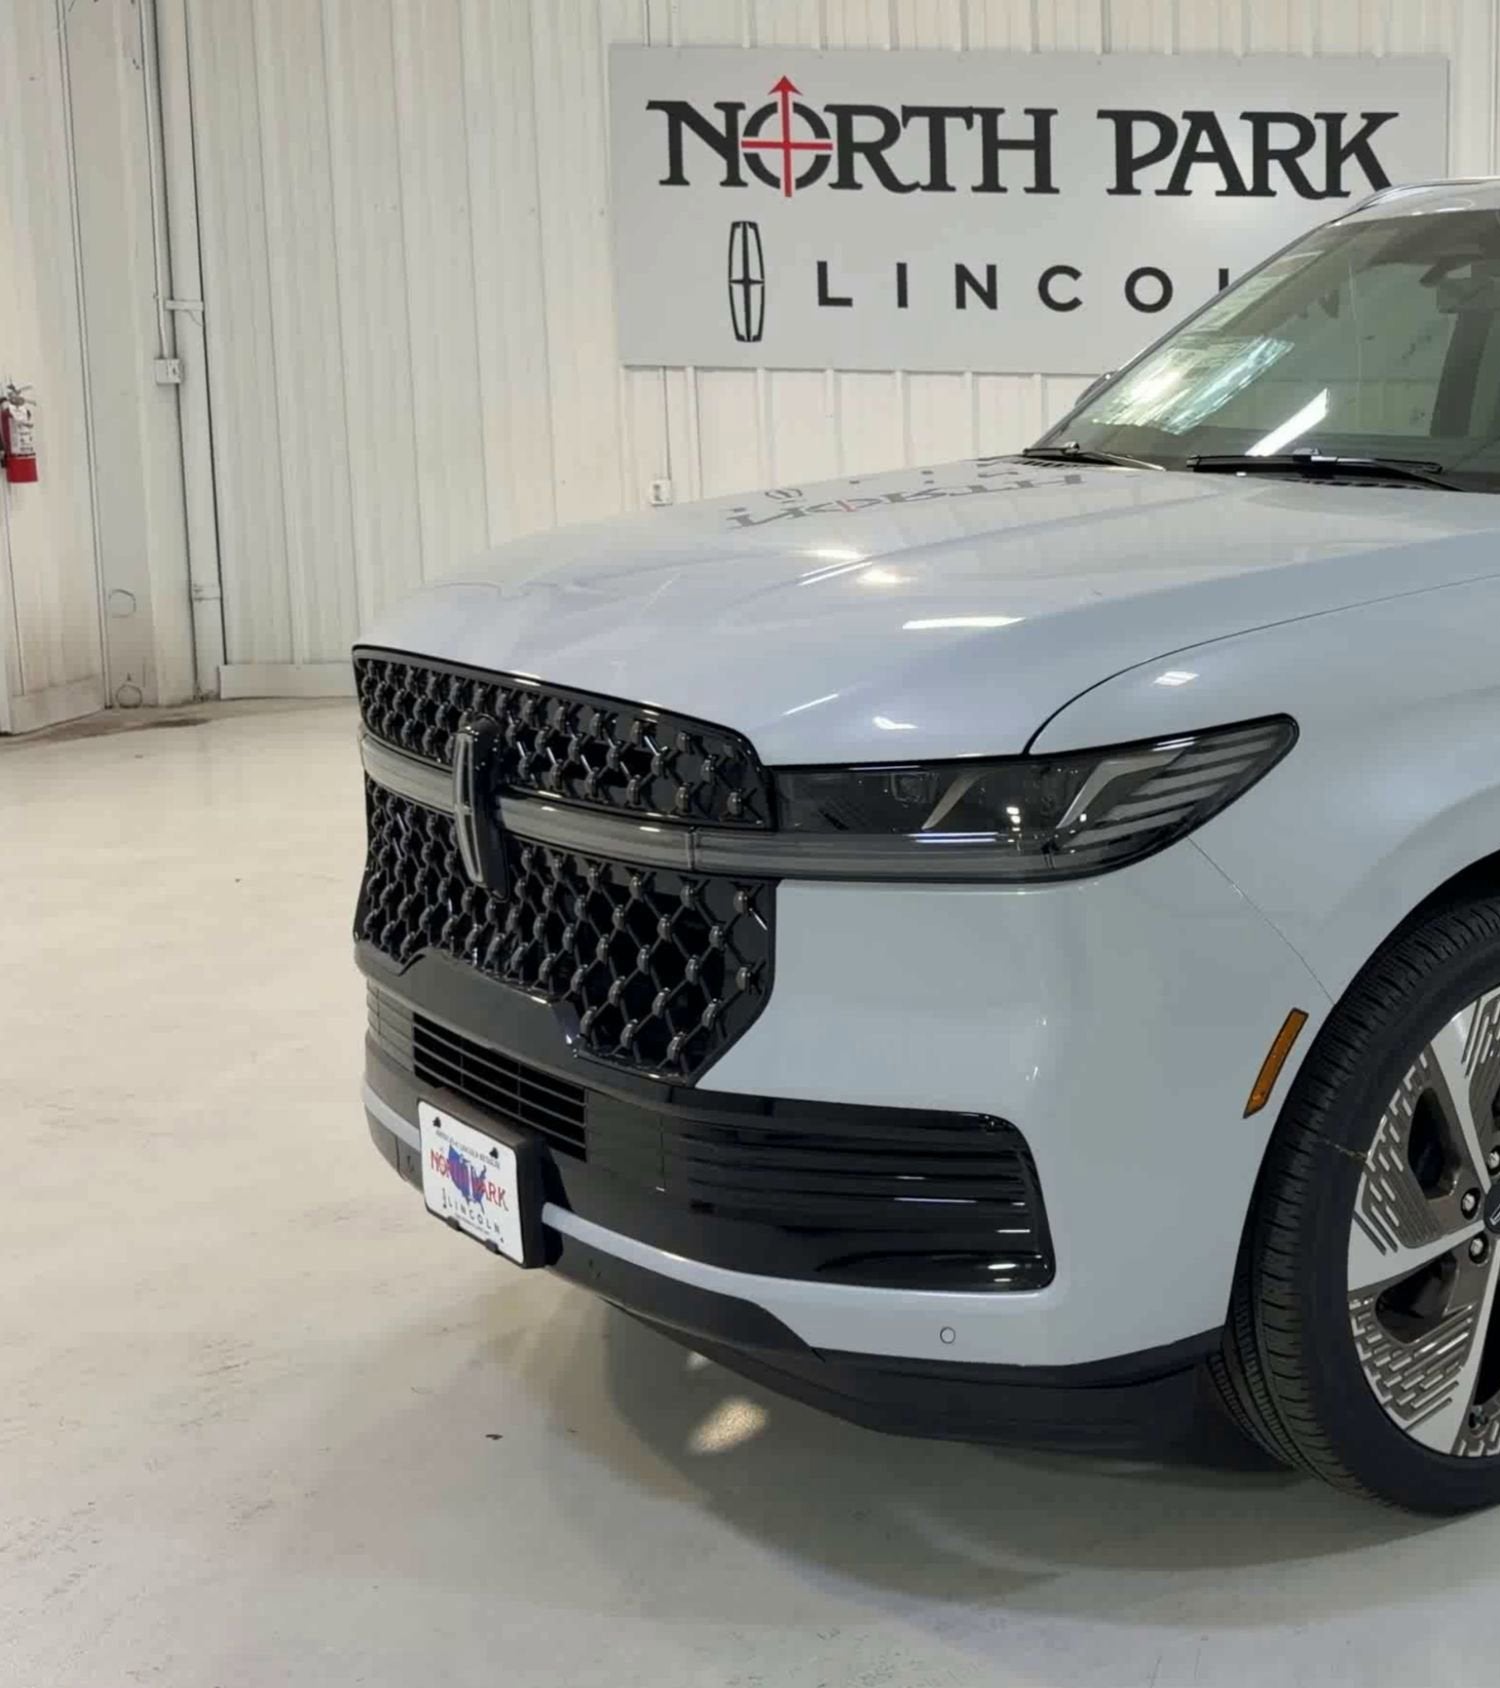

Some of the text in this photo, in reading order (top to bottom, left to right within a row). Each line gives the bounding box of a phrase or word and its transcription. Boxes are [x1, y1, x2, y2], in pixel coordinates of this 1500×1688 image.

[645, 98, 1399, 200] NORTH PARK
[447, 1196, 500, 1234] LINCOLN
